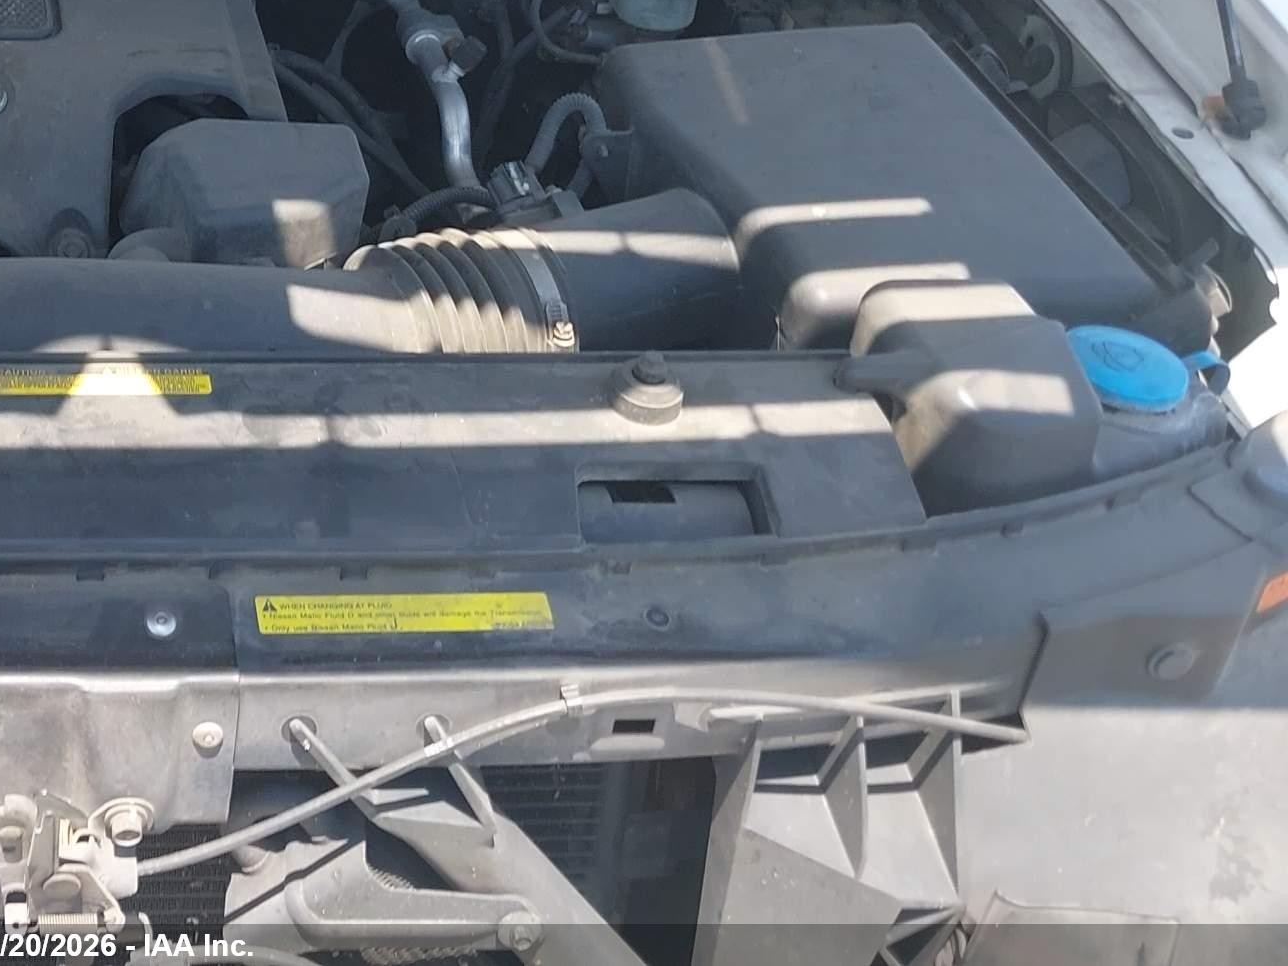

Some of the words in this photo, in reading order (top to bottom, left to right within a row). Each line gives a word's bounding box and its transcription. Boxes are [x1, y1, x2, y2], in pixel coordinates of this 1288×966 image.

[279, 602, 306, 610] WHEN
[307, 602, 354, 610] CHANGING
[271, 625, 290, 633] Only
